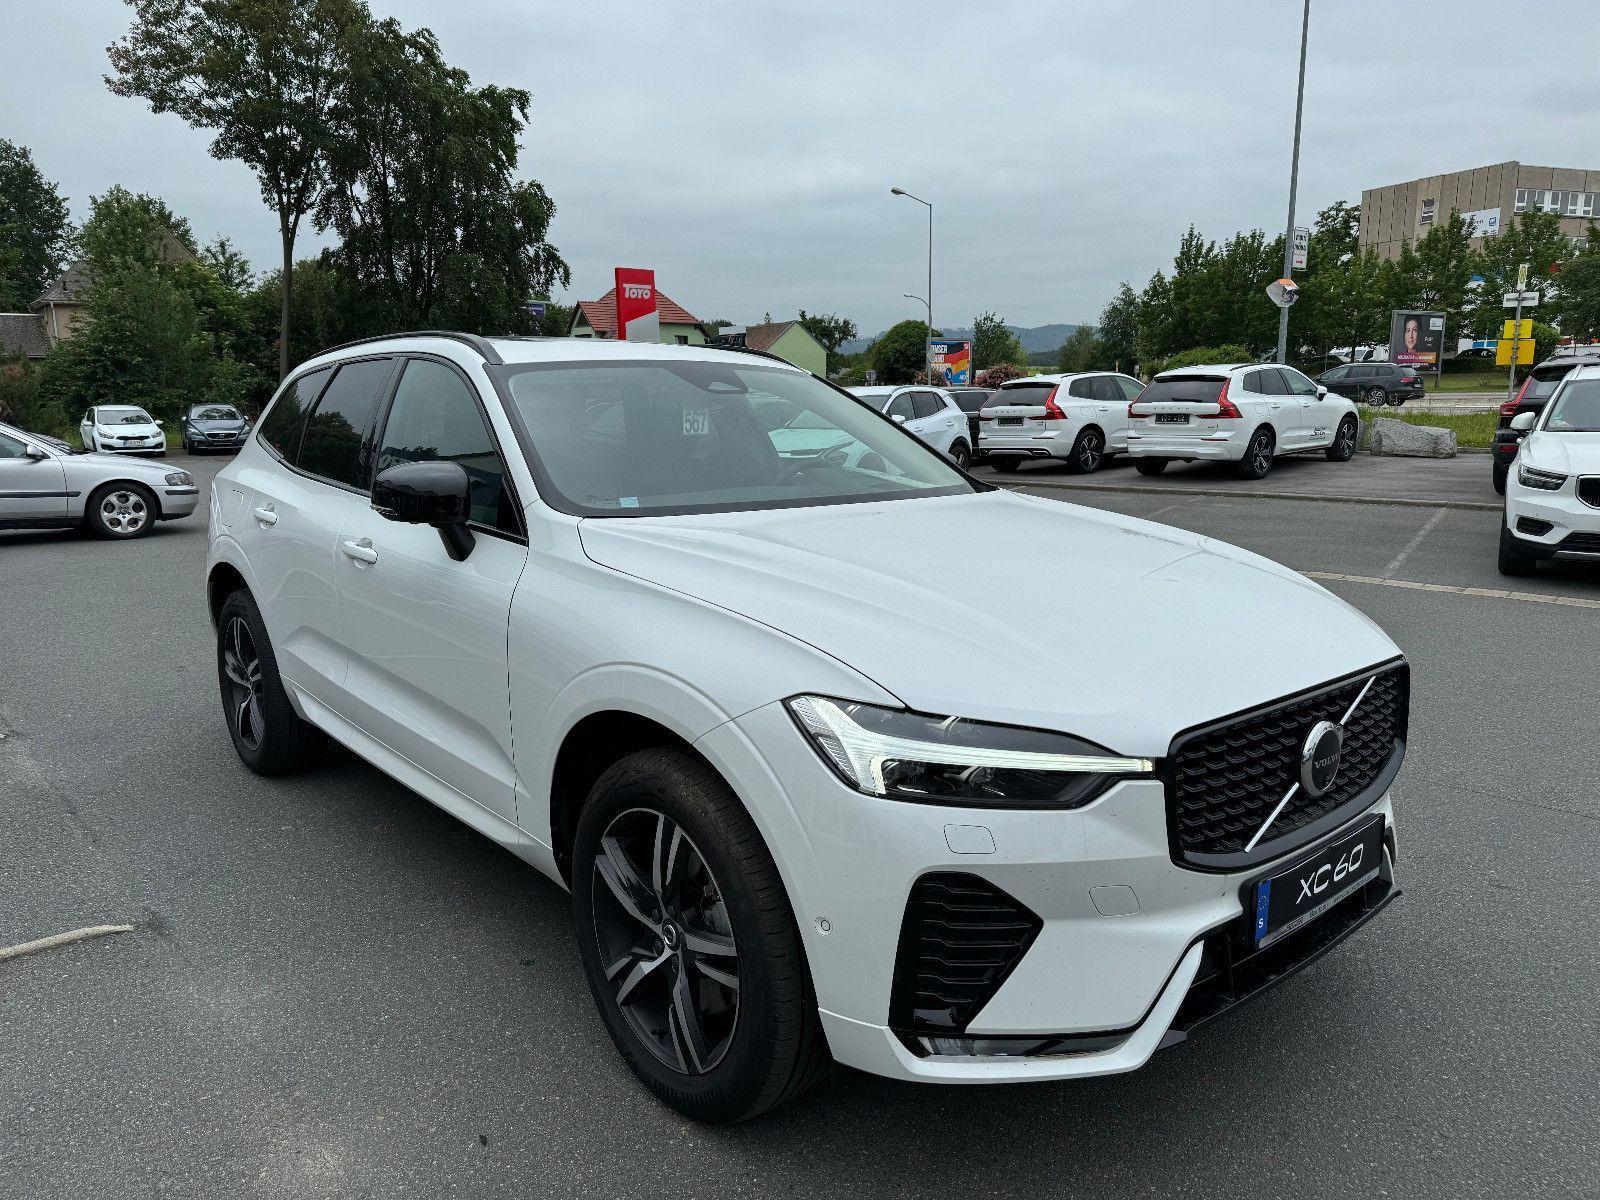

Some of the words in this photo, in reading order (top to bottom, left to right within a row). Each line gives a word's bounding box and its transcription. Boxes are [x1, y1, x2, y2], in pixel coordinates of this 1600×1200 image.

[684, 411, 707, 434] 567
[1296, 843, 1364, 905] XC60
[1258, 918, 1264, 929] S
